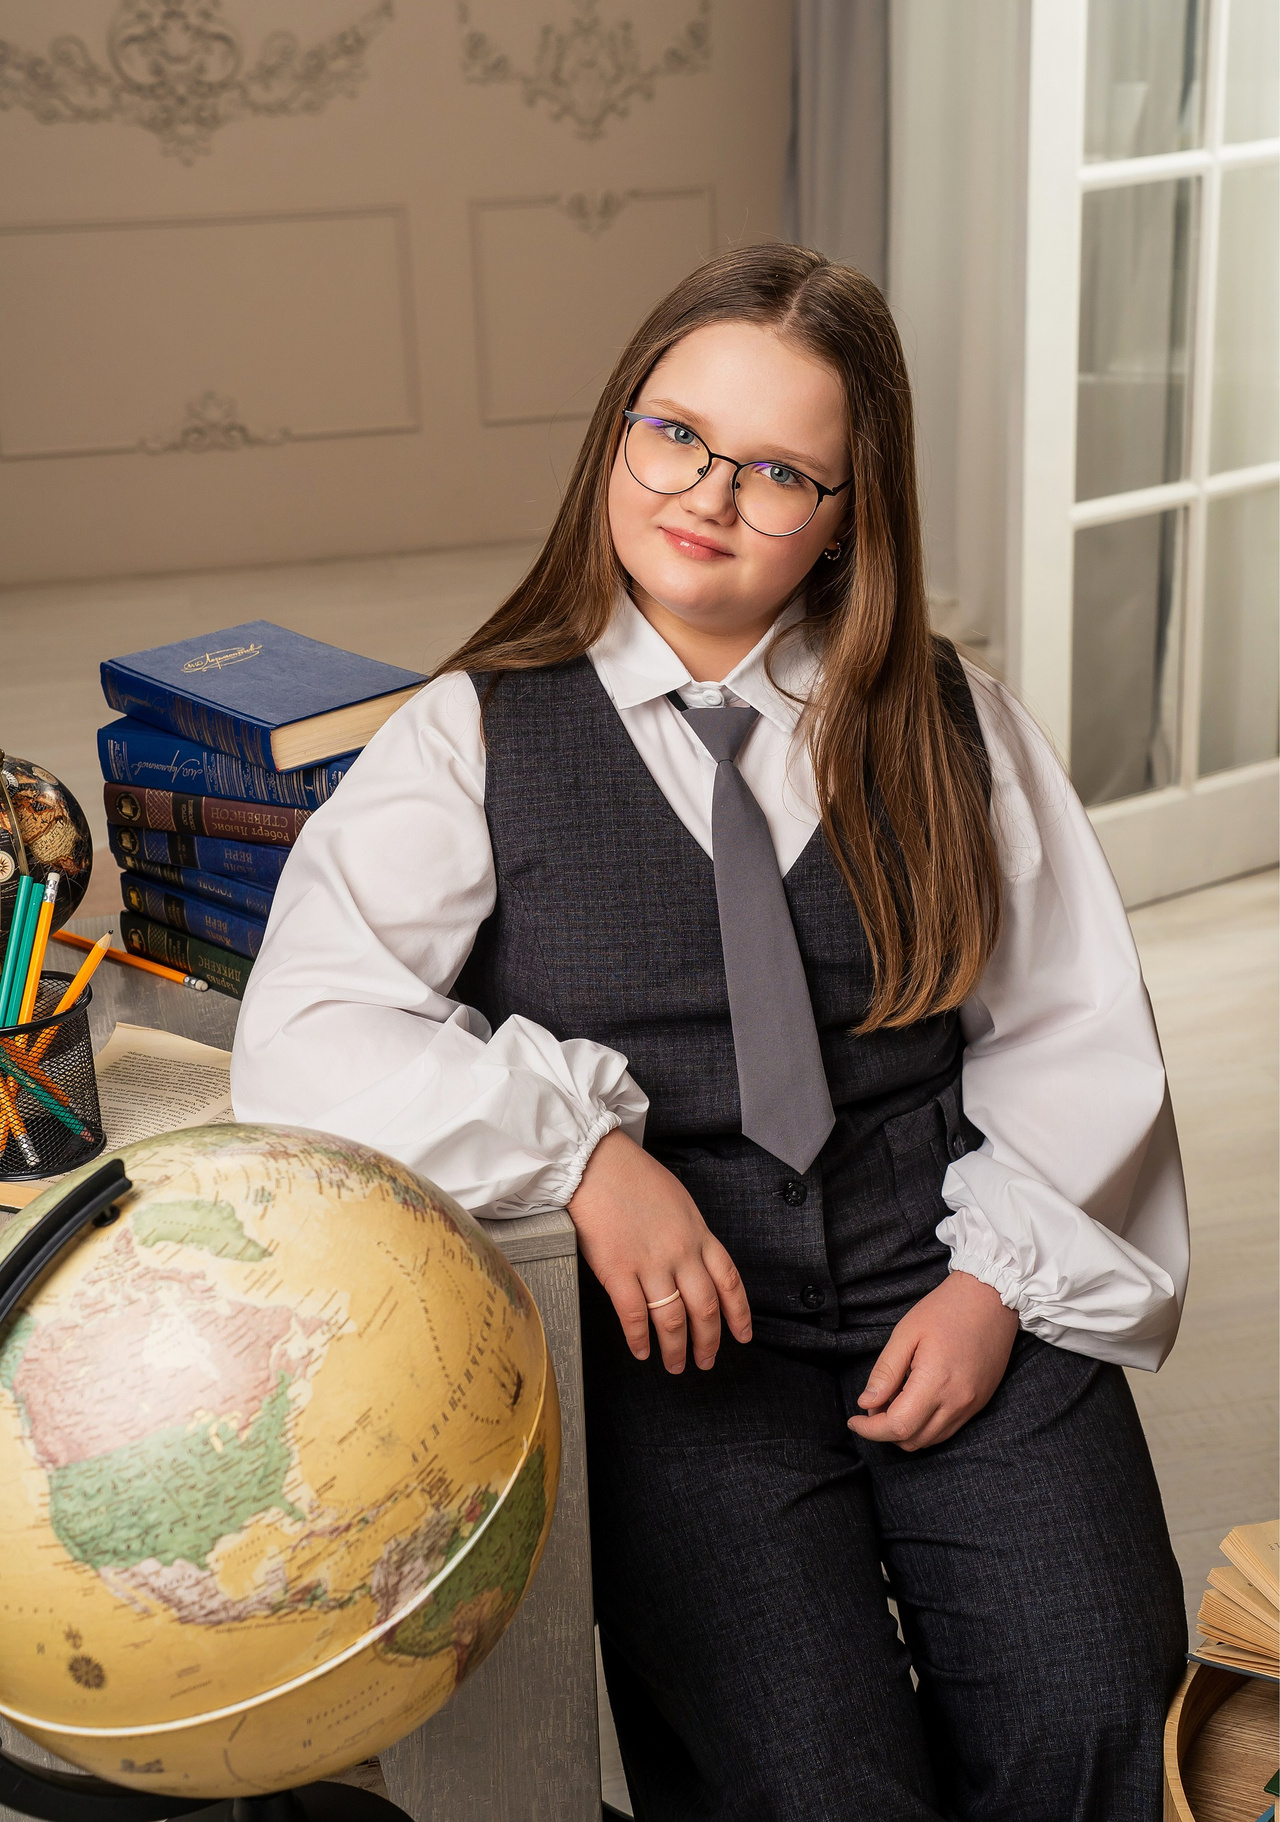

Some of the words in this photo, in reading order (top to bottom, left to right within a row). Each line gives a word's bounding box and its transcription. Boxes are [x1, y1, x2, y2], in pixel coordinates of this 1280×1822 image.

[210, 807, 288, 828] СТИВЕНСОН
[211, 822, 248, 836] Льюис
[251, 826, 290, 841] Роберт
[224, 848, 252, 865] ВЕРН
[204, 915, 228, 933] ВЕРН
[197, 955, 242, 982] ДИККЕНС
[206, 974, 238, 994] Чарльз
